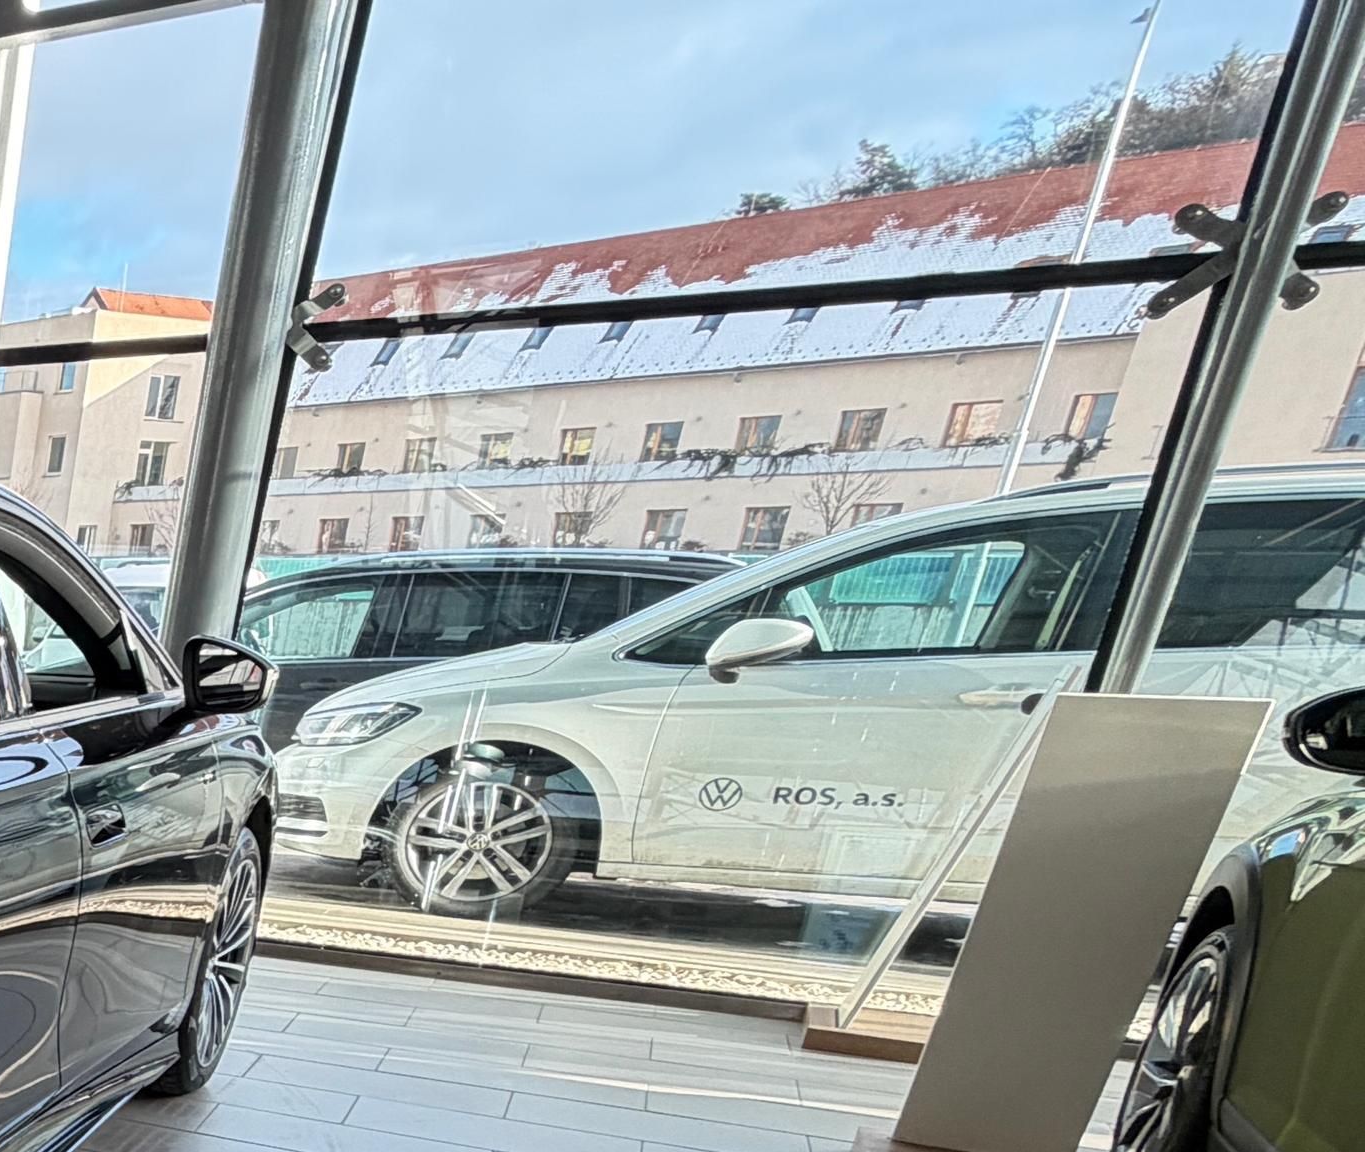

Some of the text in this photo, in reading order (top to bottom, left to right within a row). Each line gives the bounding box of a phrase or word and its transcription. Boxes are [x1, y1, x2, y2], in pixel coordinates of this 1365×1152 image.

[699, 777, 743, 811] VW
[772, 786, 905, 810] ROS, a.s.
